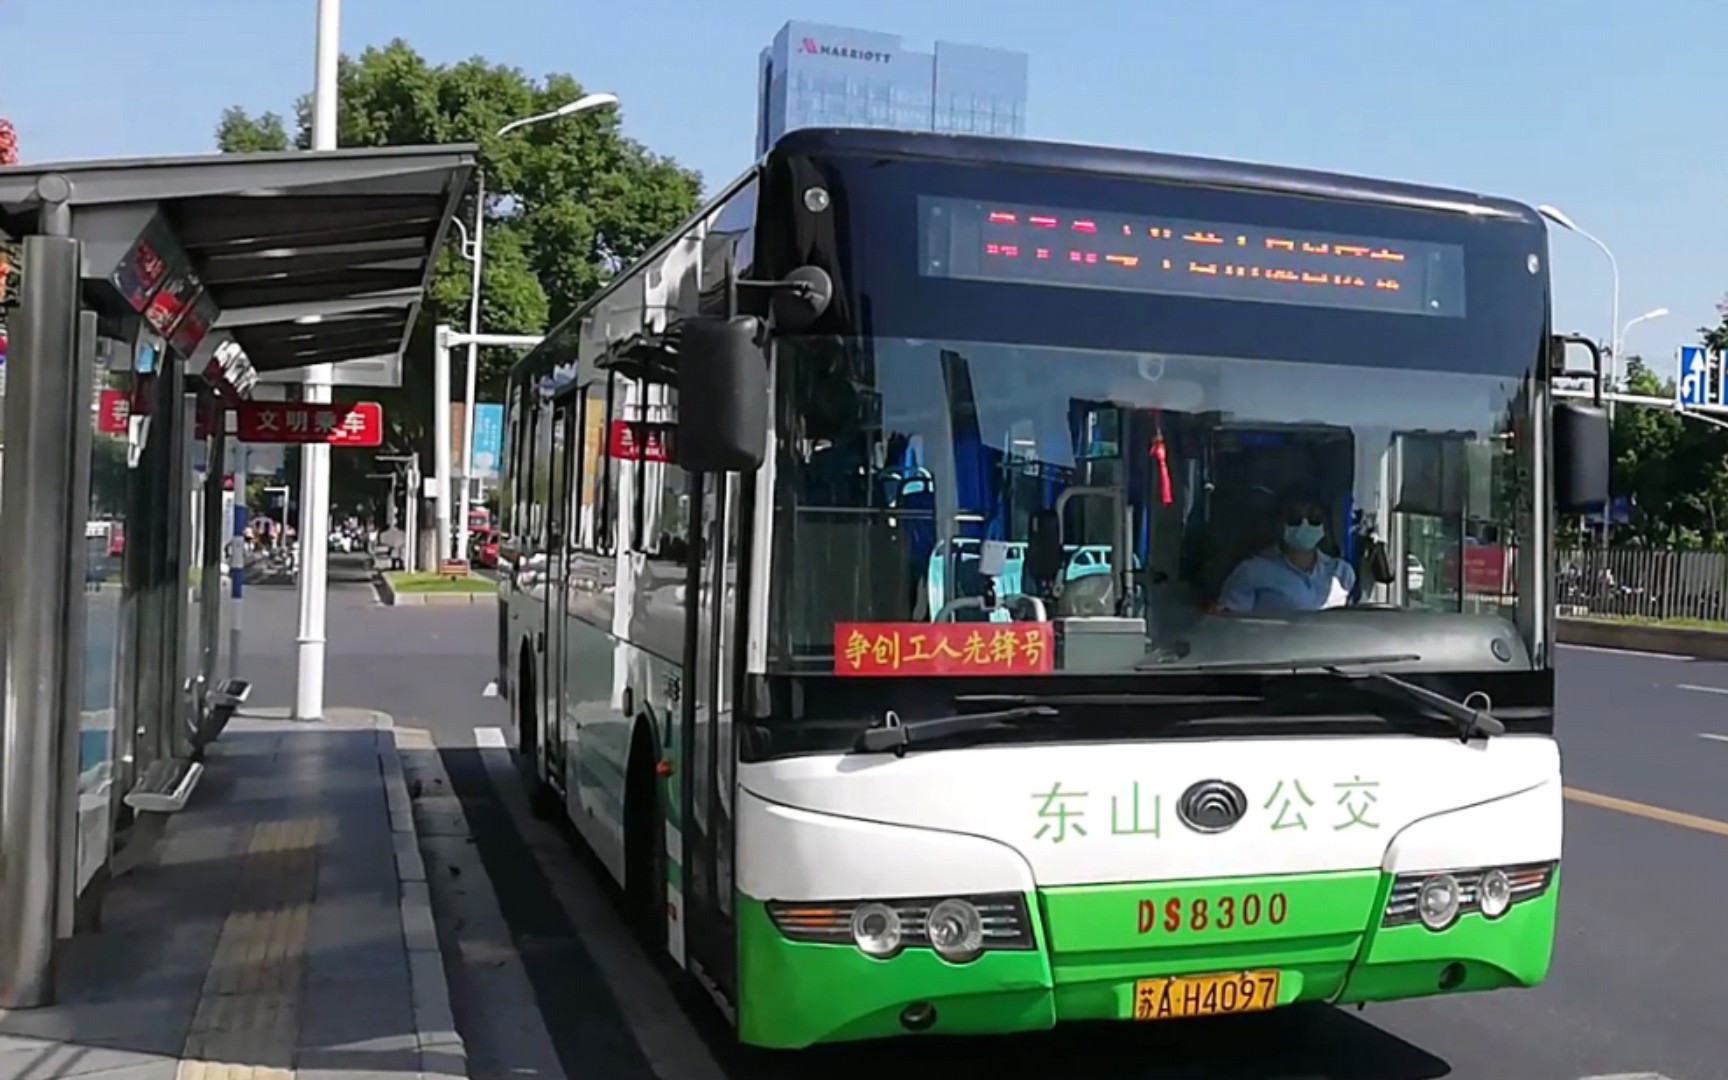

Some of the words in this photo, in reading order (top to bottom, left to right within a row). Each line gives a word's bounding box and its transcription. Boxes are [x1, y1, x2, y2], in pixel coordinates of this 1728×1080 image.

[820, 45, 891, 63] MARRIOTT
[256, 409, 366, 433] 文明乘车
[846, 629, 1045, 669] 争创工人先锋号
[1031, 780, 1162, 844] 东山
[1263, 774, 1381, 832] 公交
[1137, 892, 1287, 934] DS8300
